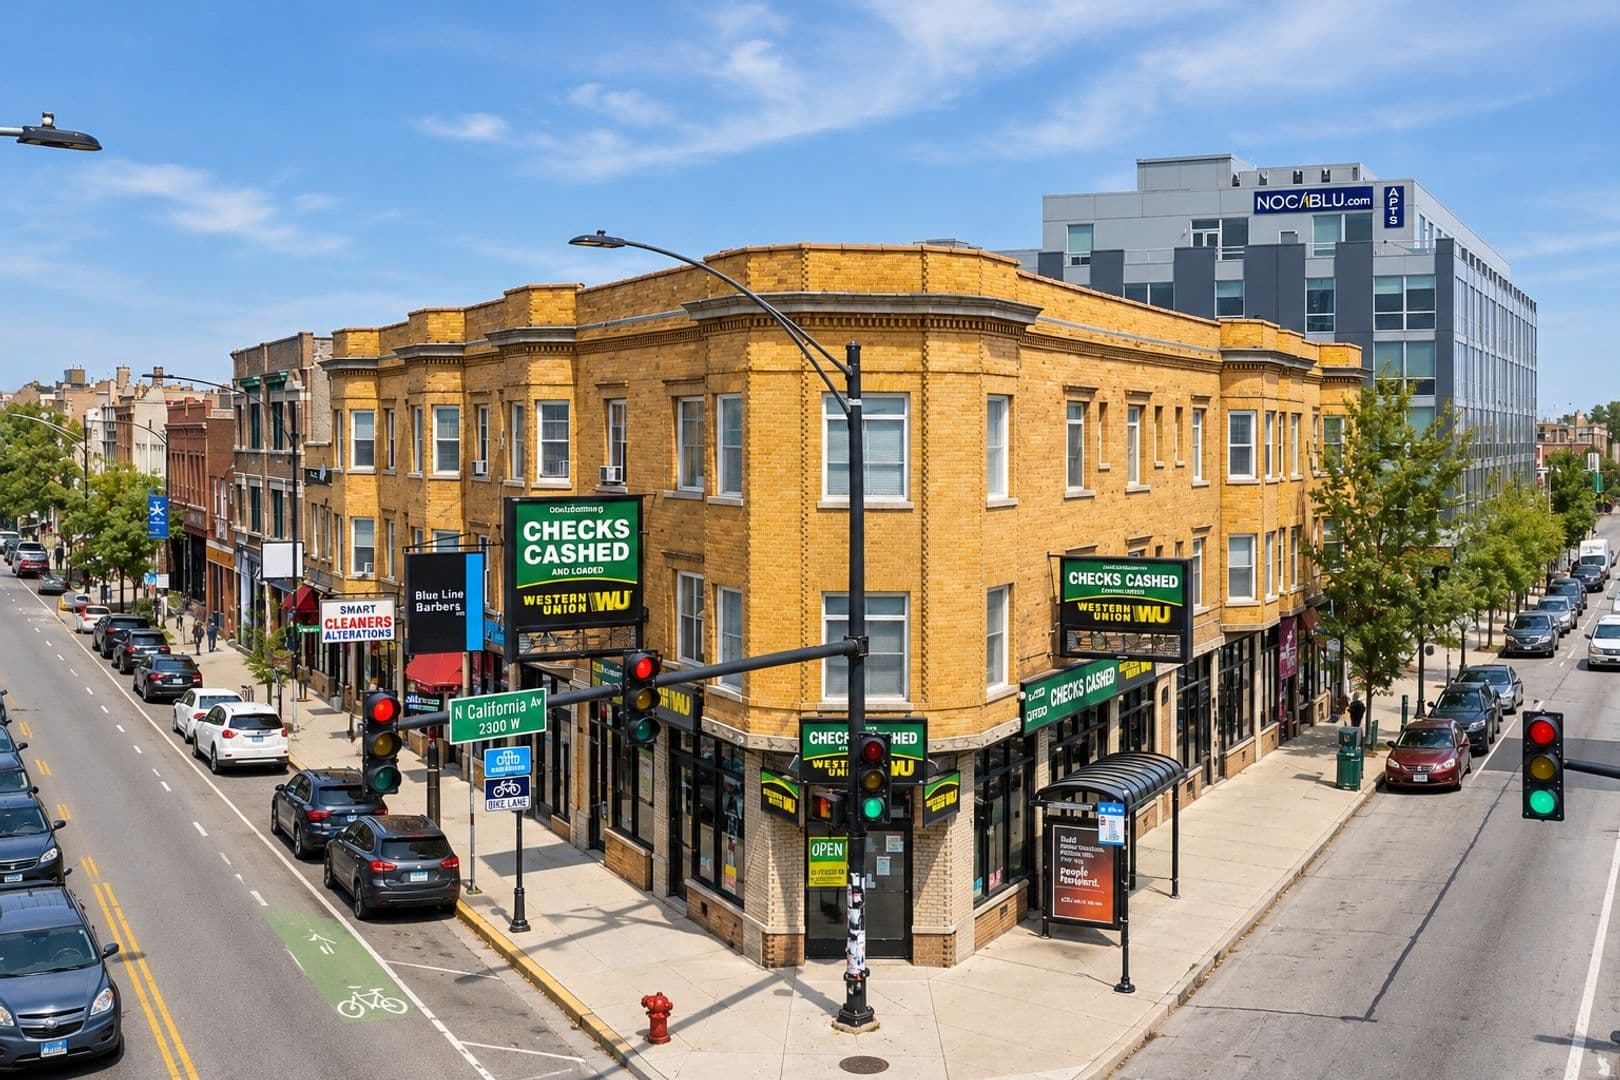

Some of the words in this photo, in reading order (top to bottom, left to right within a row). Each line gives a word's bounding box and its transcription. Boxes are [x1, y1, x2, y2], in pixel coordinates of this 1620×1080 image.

[1388, 187, 1399, 225] APTS
[523, 519, 630, 542] CHECKS
[524, 541, 630, 565] CASHED
[1069, 571, 1122, 586] CHECKS
[1125, 573, 1179, 589] CASHED
[415, 590, 438, 601] Blue
[441, 588, 464, 600] Line
[523, 592, 587, 606] WESTERN
[589, 590, 632, 612] WU
[340, 604, 376, 615] SMART
[416, 601, 461, 613] Barbers
[543, 603, 587, 615] UNION
[1077, 602, 1131, 613] WESTERN
[1133, 605, 1171, 623] WU
[324, 616, 392, 630] CLEANERS
[1093, 612, 1131, 622] UNION
[324, 628, 392, 641] ALTERATIONS
[1050, 678, 1084, 707] CHECKS
[1085, 666, 1115, 693] CASHED
[455, 705, 463, 720] N
[467, 698, 526, 720] California
[530, 696, 542, 708] Av
[479, 721, 507, 735] 2300
[511, 718, 520, 730] W
[811, 842, 843, 857] OPEN
